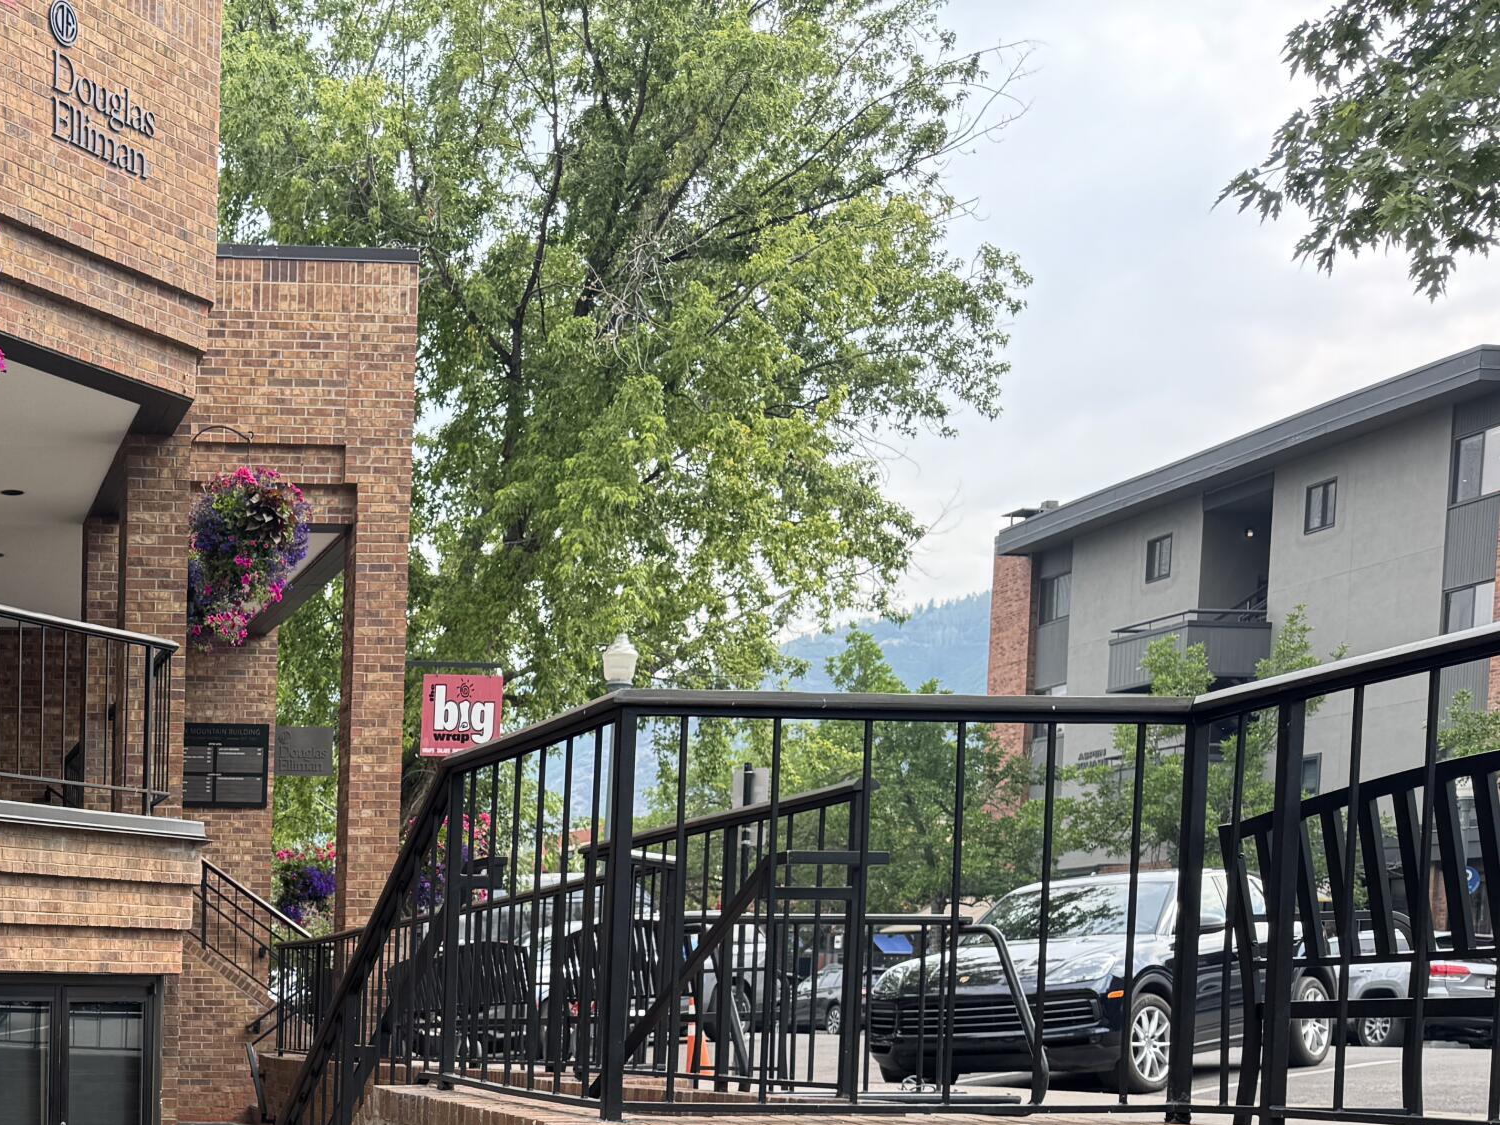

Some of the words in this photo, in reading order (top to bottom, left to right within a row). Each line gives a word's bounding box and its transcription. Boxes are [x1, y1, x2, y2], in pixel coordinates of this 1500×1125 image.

[52, 50, 156, 138] Douglas
[51, 97, 148, 179] Elliman
[433, 683, 496, 744] big
[229, 728, 261, 736] BUILDING
[433, 733, 470, 744] wrap
[278, 745, 328, 762] Douglas
[278, 759, 324, 772] Elliman
